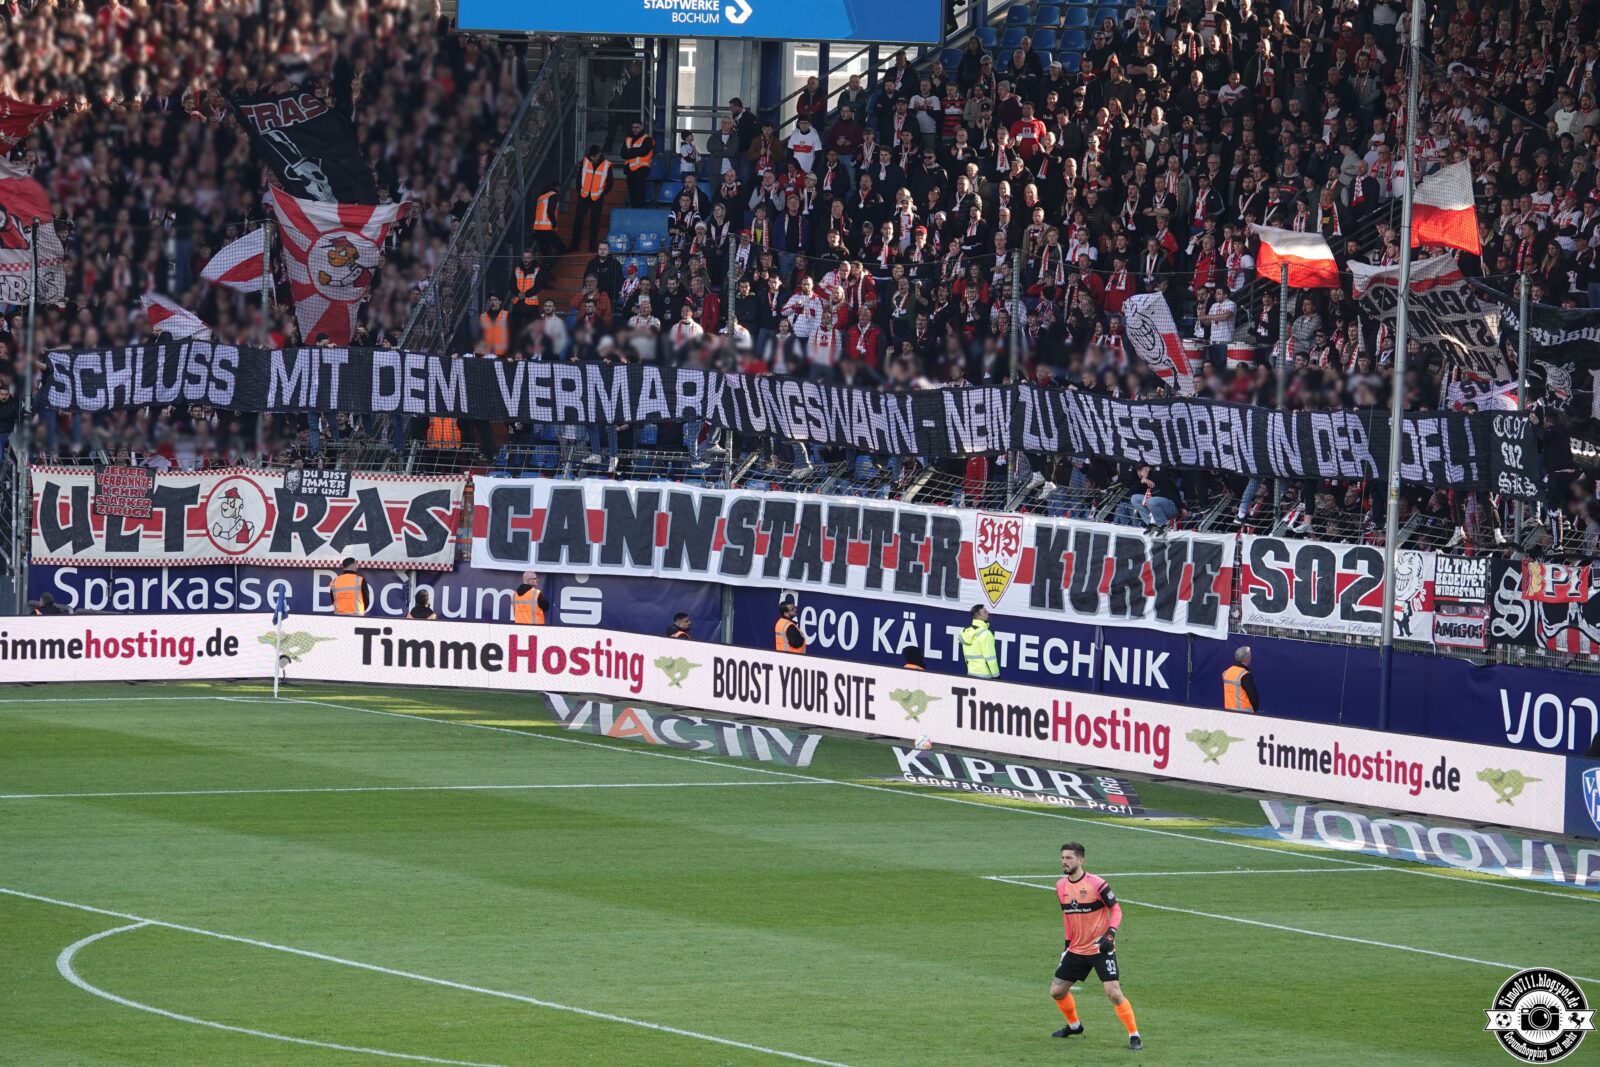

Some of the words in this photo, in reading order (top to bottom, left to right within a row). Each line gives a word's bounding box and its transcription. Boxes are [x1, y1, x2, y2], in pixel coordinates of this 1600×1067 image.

[643, 0, 720, 11] STADTWERKE
[671, 12, 720, 24] BOCHUM
[48, 341, 240, 411] SCHLUSS
[266, 348, 349, 410] MIT
[371, 350, 469, 413] DEM
[494, 361, 918, 455] VERMARKTUNGSWAHN
[942, 387, 1012, 454] NEIN
[1018, 384, 1059, 452] ZU
[1059, 389, 1257, 475] INVESTOREN
[1267, 411, 1304, 477] IN
[1311, 412, 1379, 479] DER
[97, 473, 153, 489] VERBANNTE
[104, 465, 147, 476] JEDER
[302, 478, 346, 488] IMMER
[303, 470, 319, 478] DU
[322, 470, 347, 480] BIST
[102, 486, 147, 497] KEHRT
[321, 488, 346, 496] UNS!
[486, 485, 963, 601] CANNSTATTER
[1028, 523, 1225, 630] KURVE
[1436, 556, 1486, 574] ULTRAS
[53, 566, 293, 611] Sparkasse
[312, 569, 513, 620] Bchum
[1249, 537, 1386, 622] S02
[1435, 585, 1486, 598] WIDERSTAND
[1436, 573, 1486, 587] BEDEUTET
[355, 627, 644, 693] TimmeHosting
[872, 611, 1170, 689] KÄLTTECHNIK
[713, 656, 774, 705] BOOST
[779, 665, 829, 716] YOUR
[834, 672, 876, 720] SITE
[542, 691, 822, 767] VIACTIV
[951, 686, 1170, 770] TimmeHosting
[892, 746, 1093, 800] KIPOR
[1257, 734, 1461, 796] timmehosting.de
[903, 771, 1025, 799] Generatoren
[1035, 793, 1076, 807] vom
[1087, 799, 1134, 816] Profi
[1105, 959, 1117, 972] 33
